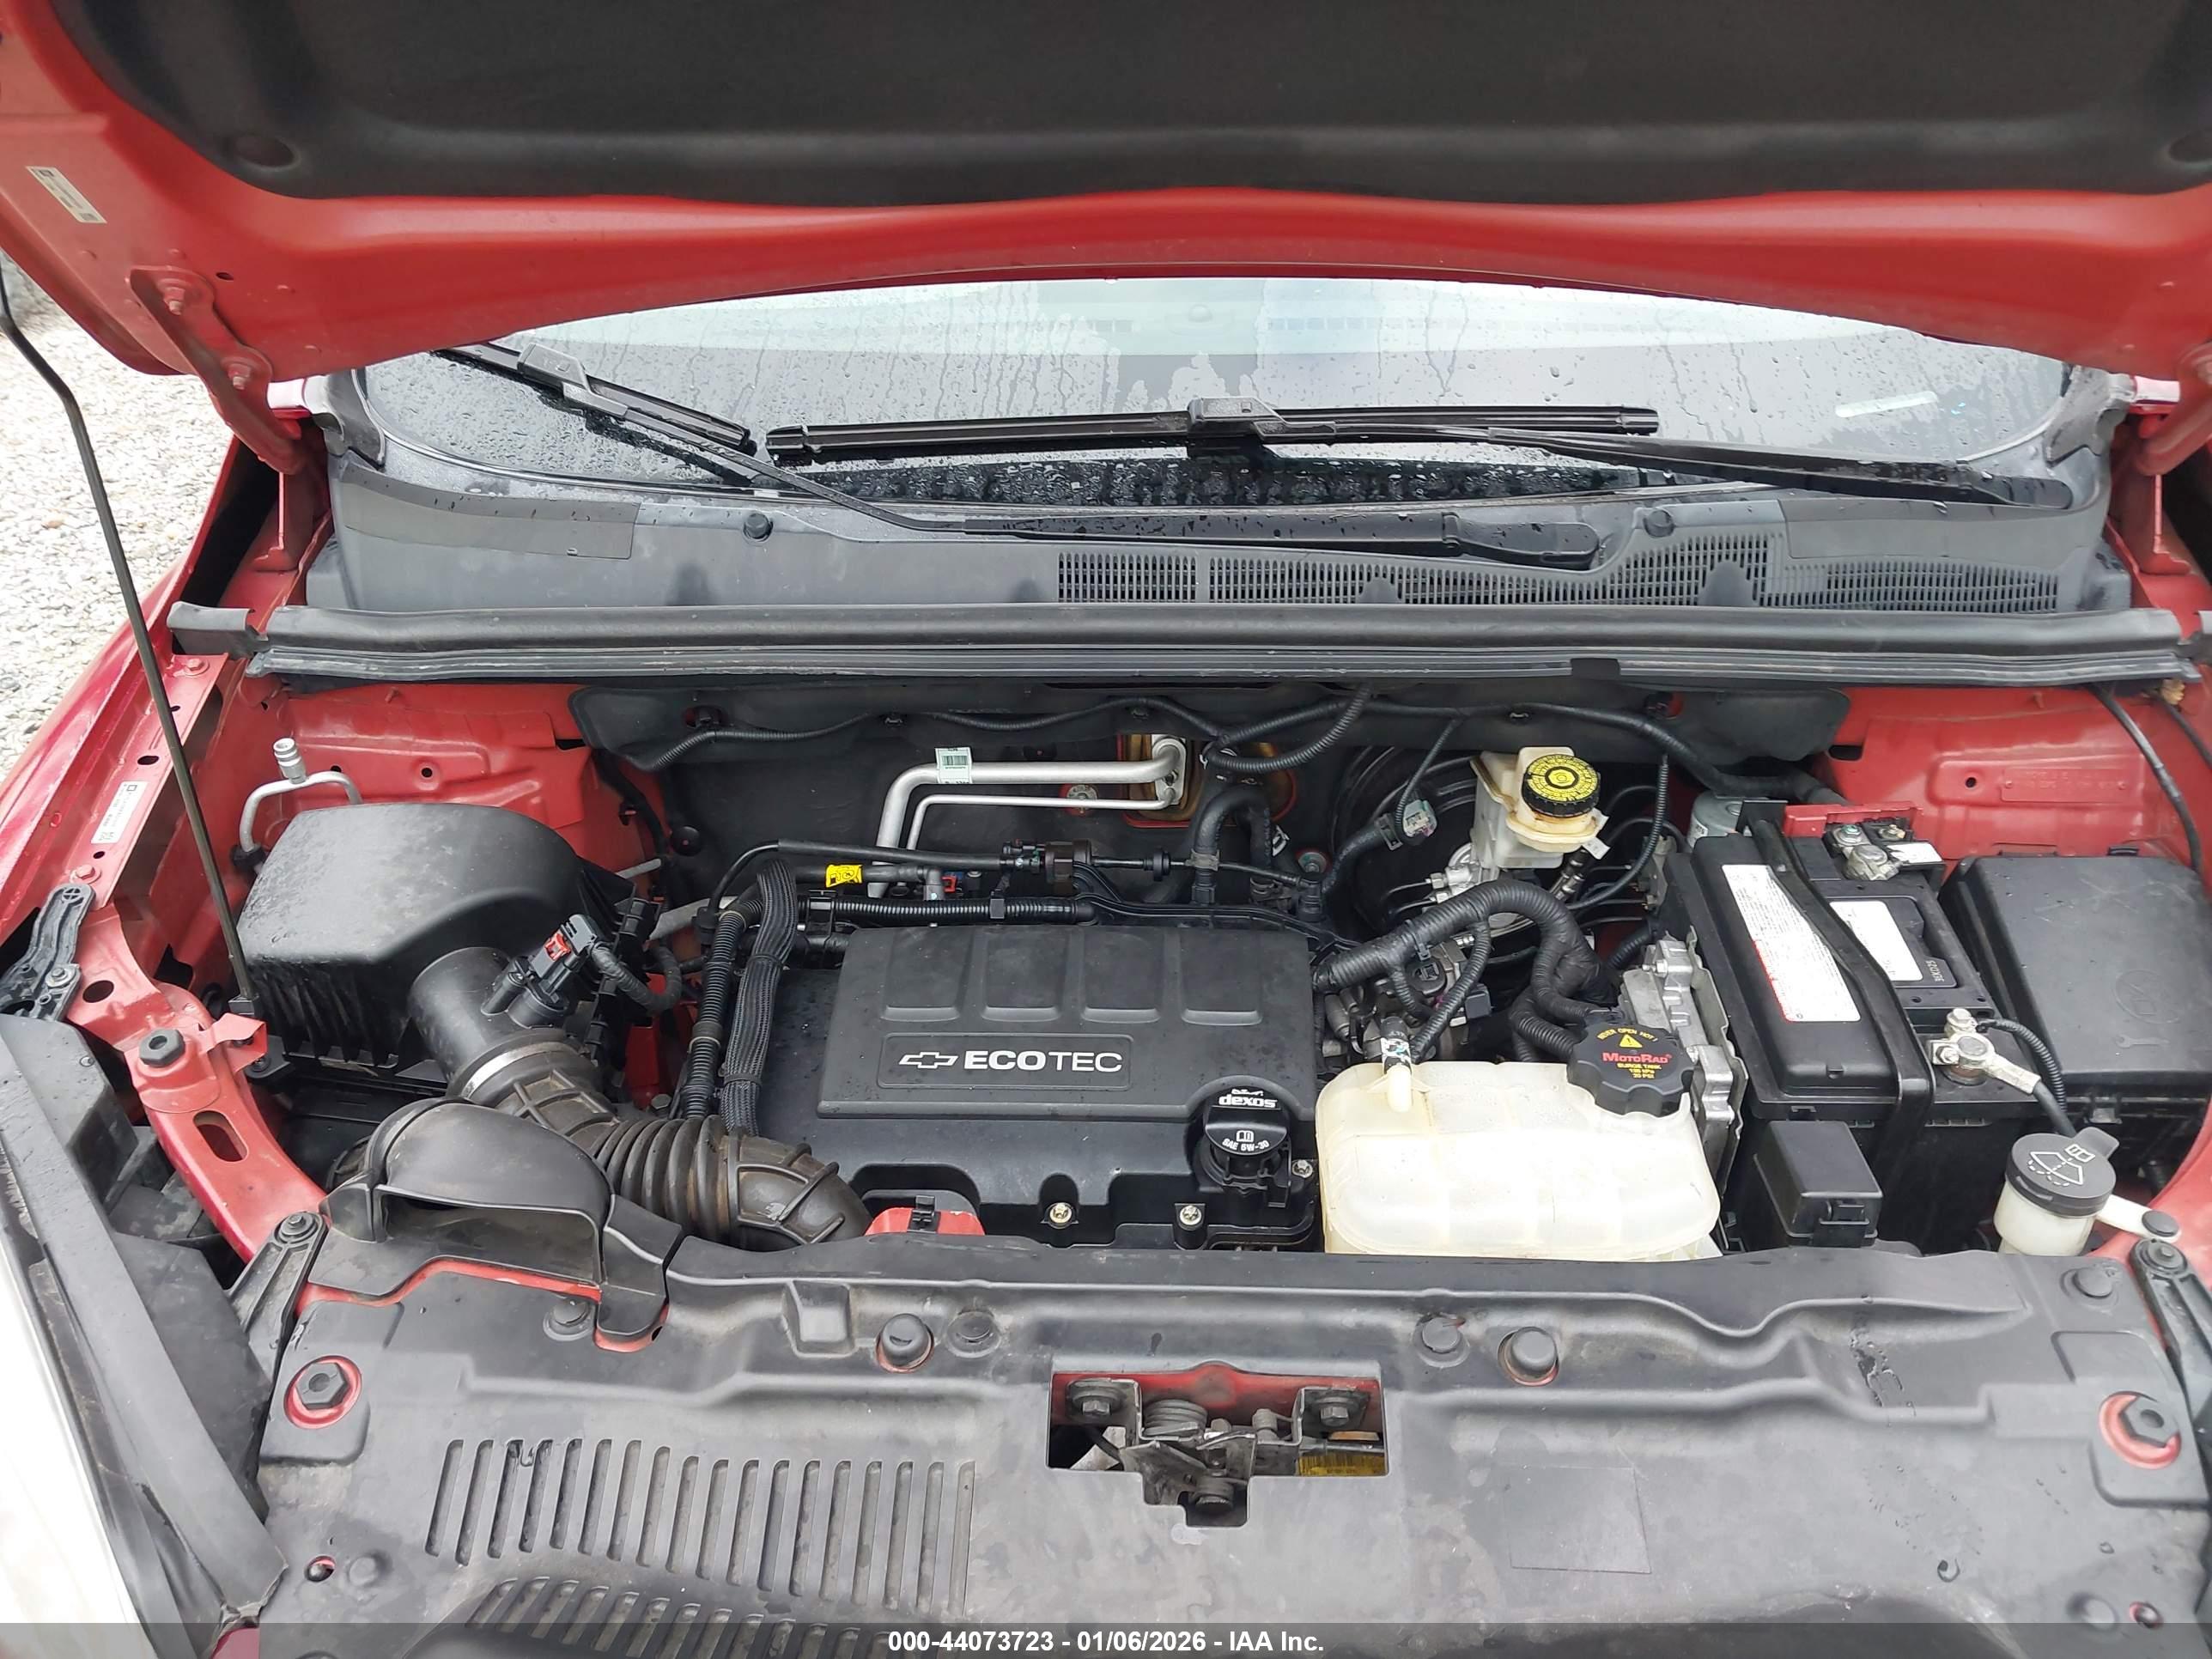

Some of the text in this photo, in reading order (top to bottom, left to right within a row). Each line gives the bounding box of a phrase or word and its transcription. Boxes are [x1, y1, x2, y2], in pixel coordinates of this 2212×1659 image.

[1639, 1031, 1655, 1040] HOT
[964, 1050, 1122, 1073] ECOTEC
[1219, 1094, 1278, 1108] dexos
[1222, 1138, 1269, 1152] SAE 5W-30
